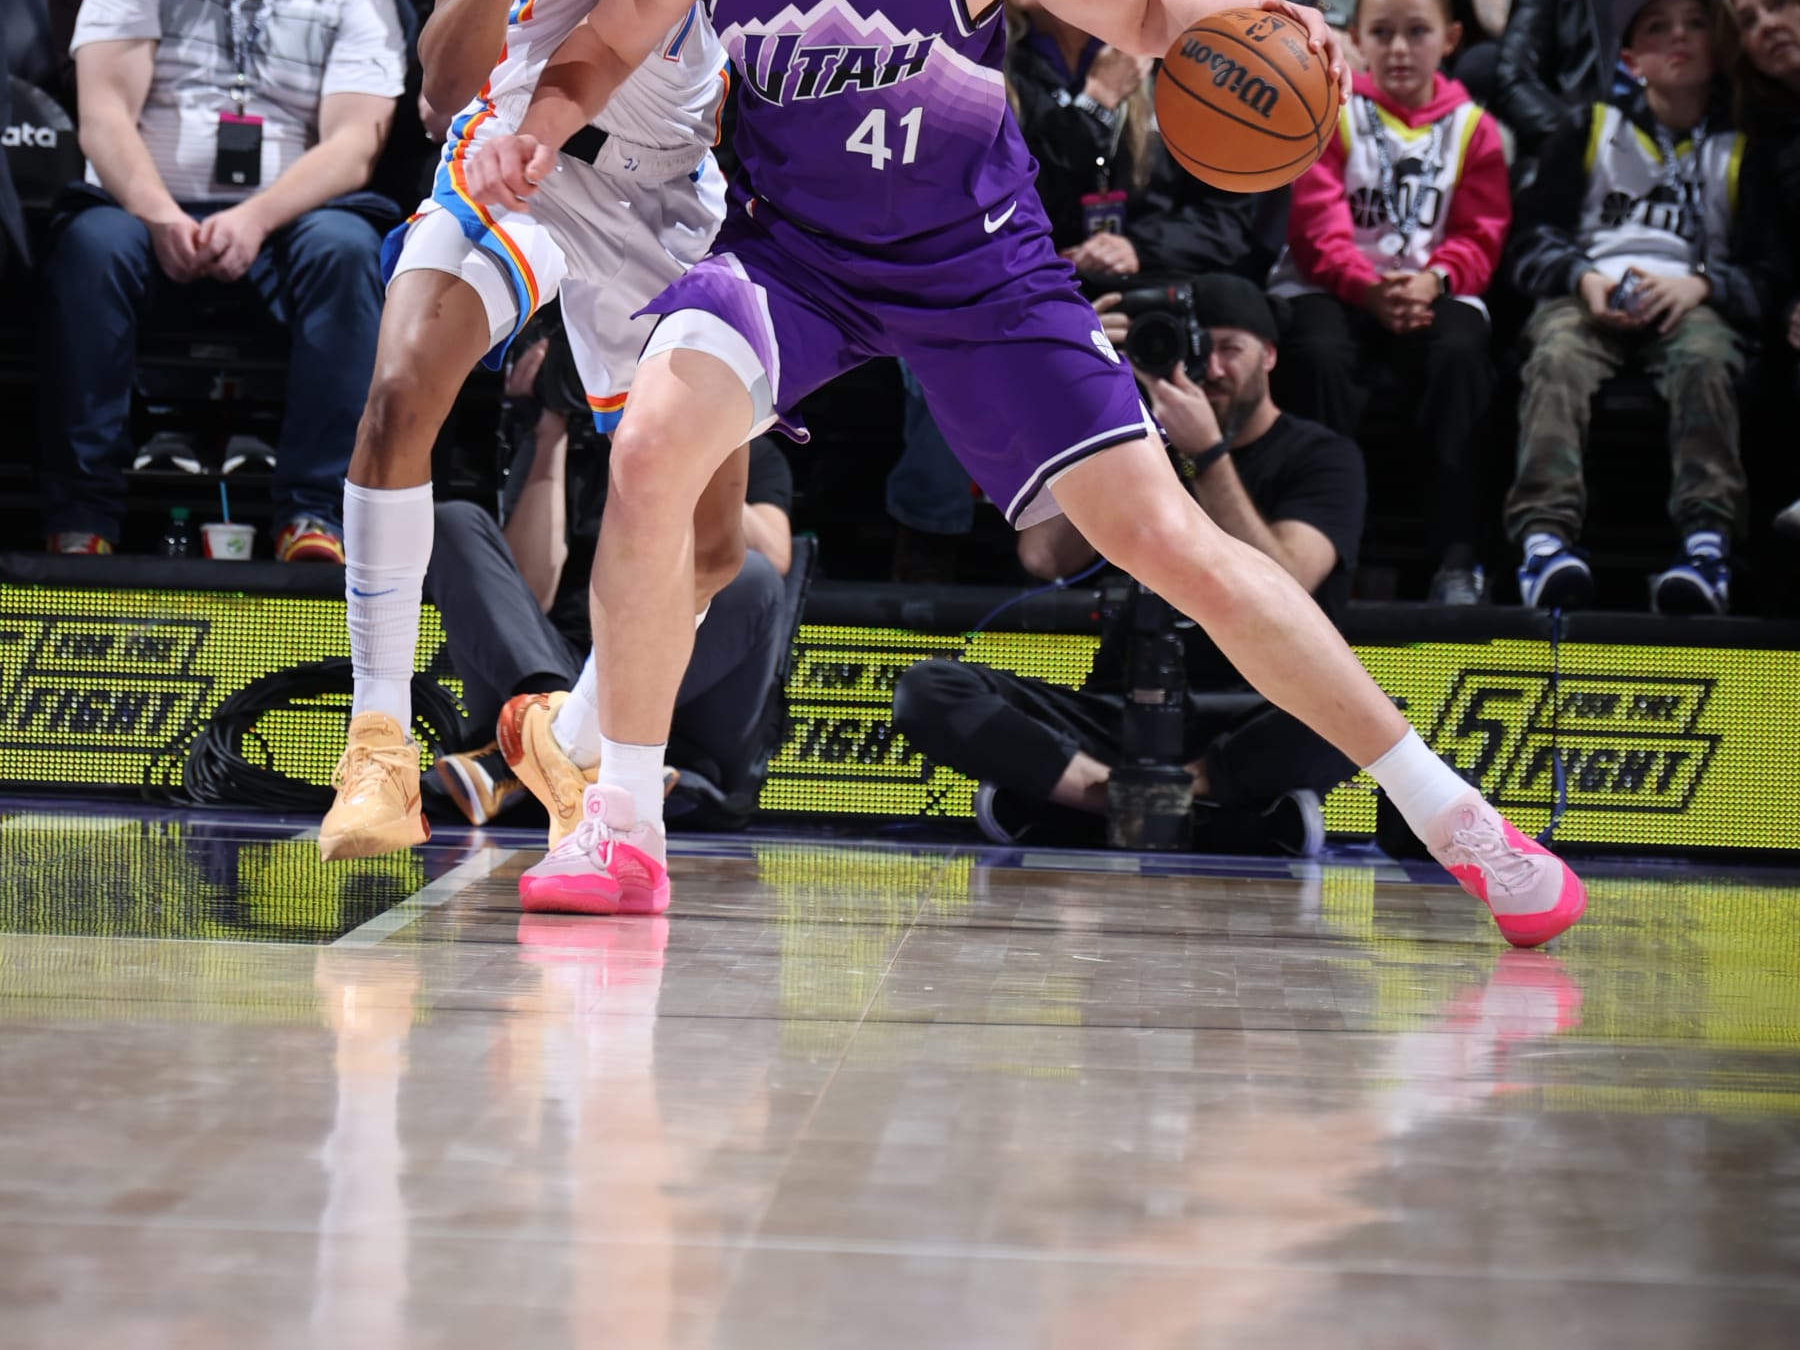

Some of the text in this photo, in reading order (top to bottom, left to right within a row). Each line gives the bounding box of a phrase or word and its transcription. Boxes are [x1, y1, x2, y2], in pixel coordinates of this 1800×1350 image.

[741, 33, 943, 107] UTAH
[1180, 38, 1280, 119] Wilson
[846, 106, 923, 170] 41
[18, 688, 182, 734] FIGHT
[1442, 687, 1524, 784] 5
[1519, 746, 1690, 795] FIGHT
